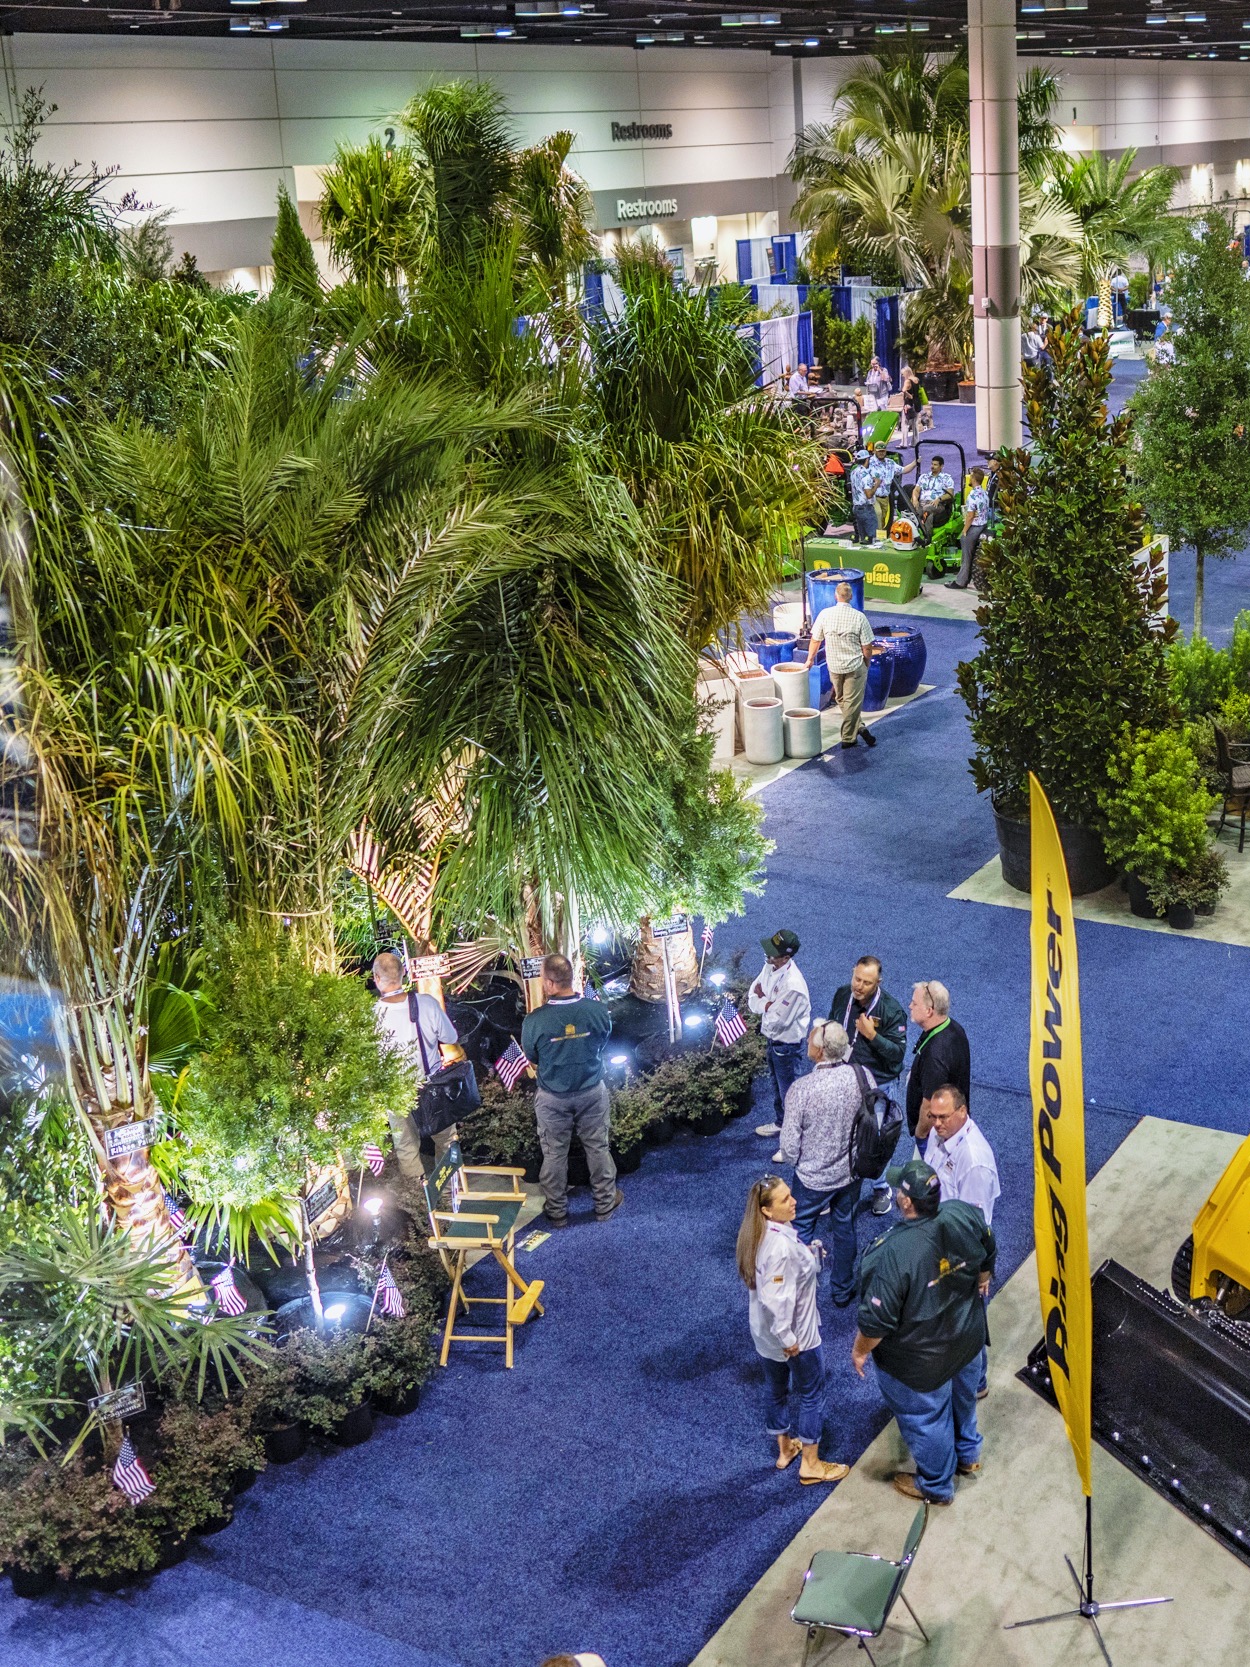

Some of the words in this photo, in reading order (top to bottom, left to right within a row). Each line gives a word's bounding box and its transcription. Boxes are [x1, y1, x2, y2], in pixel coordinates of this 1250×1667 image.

[384, 128, 396, 150] 2
[611, 122, 673, 141] Restrooms
[617, 198, 678, 219] Restrooms
[1038, 889, 1064, 1184] Power
